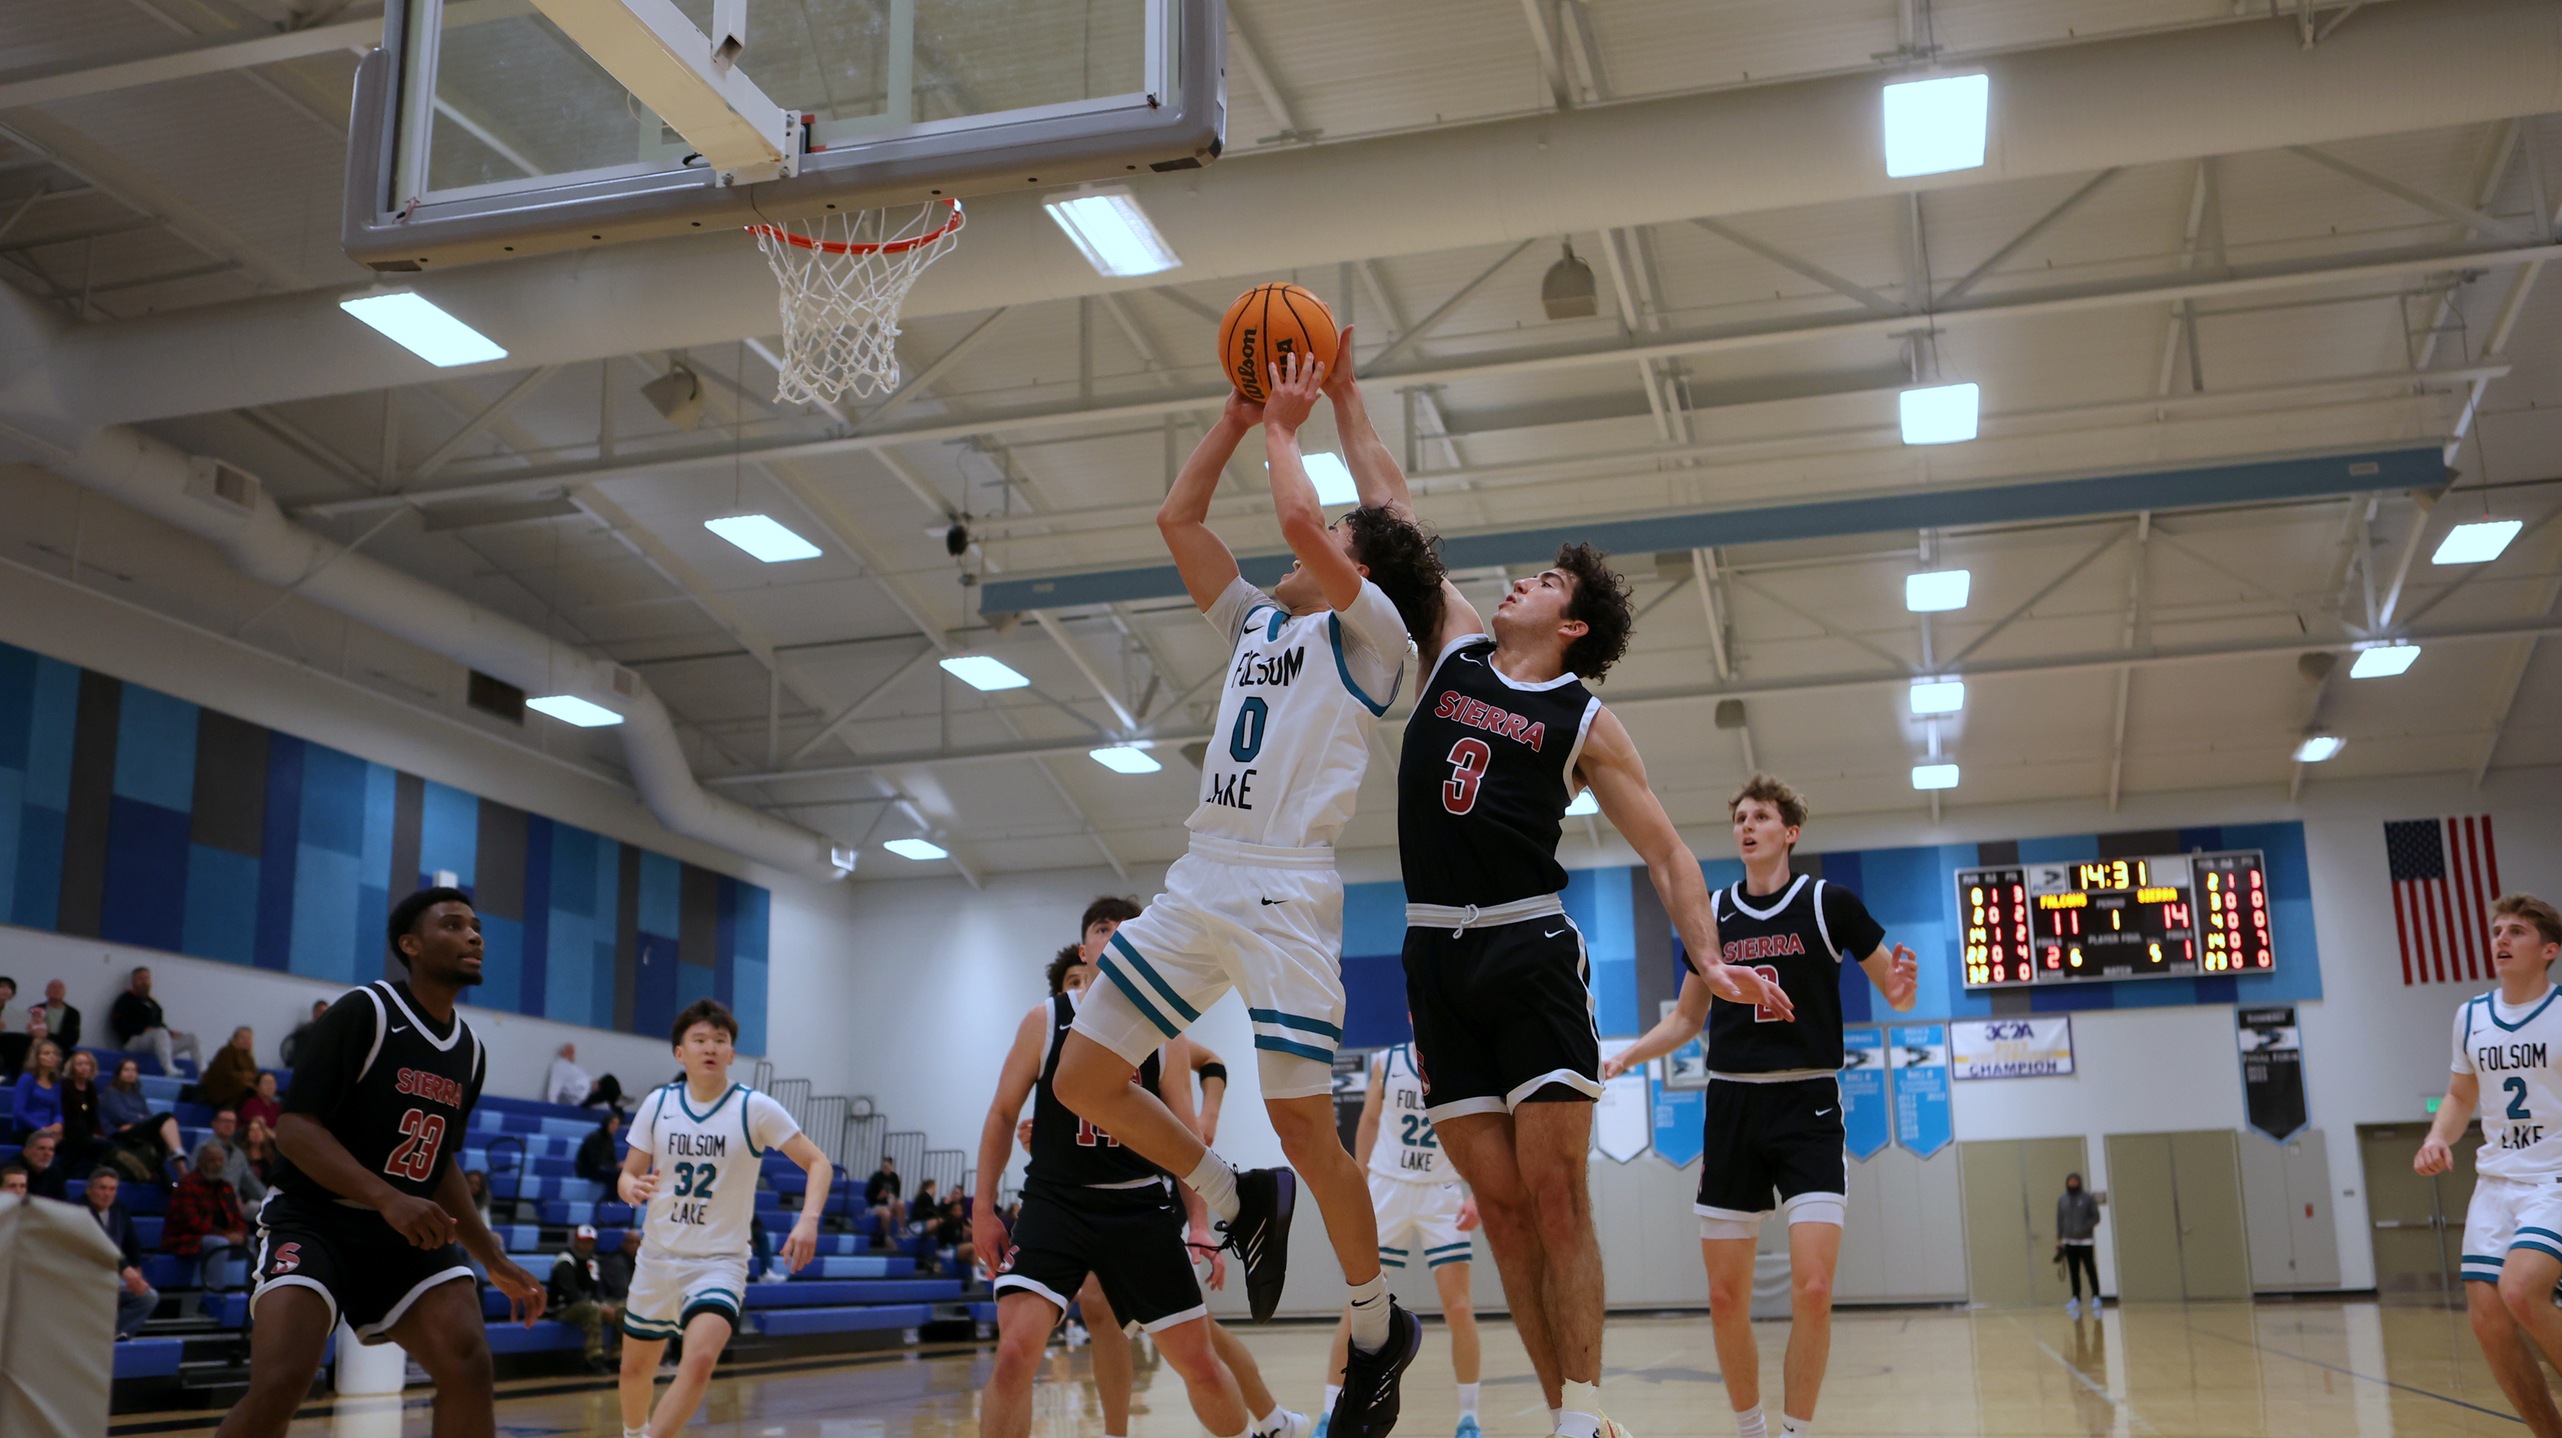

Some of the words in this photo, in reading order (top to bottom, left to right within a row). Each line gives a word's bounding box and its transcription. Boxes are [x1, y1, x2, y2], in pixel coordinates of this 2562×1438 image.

[1237, 328, 1265, 399] Wilson
[1229, 696, 1268, 762] 0
[1434, 690, 1545, 752] SIERRA
[1442, 737, 1491, 816] 3
[1205, 769, 1257, 810] AKE
[2080, 860, 2147, 890] 14:31
[2228, 872, 2235, 889] 1
[1991, 887, 1998, 903] 1
[2013, 884, 2024, 903] 3
[2040, 892, 2088, 910] FALCONS
[2137, 886, 2178, 904] SIERRA
[2224, 891, 2237, 910] 0
[2251, 889, 2263, 909] 0
[1988, 906, 2000, 924] 0
[2014, 904, 2025, 923] 2
[2053, 909, 2079, 936] 11
[2112, 908, 2121, 931] 1
[2163, 902, 2189, 930] 14
[2210, 912, 2224, 929] 4
[2226, 910, 2240, 930] 0
[2253, 909, 2266, 928] 0
[1969, 926, 1987, 944] 14
[1994, 926, 2002, 942] 1
[2015, 924, 2026, 942] 2
[2207, 932, 2226, 950] 14
[2229, 930, 2241, 950] 0
[2256, 929, 2268, 947] 7
[1724, 933, 1805, 964] SIERRA
[1991, 944, 2003, 963] 0
[2016, 944, 2029, 960] 4
[2046, 945, 2061, 969] 2
[2069, 947, 2083, 968] 6
[2184, 939, 2193, 960] 1
[2231, 950, 2244, 970] 0
[2257, 948, 2270, 968] 0
[1993, 964, 2005, 982] 0
[2018, 962, 2031, 981] 0
[1969, 1060, 2057, 1077] CHAMPION
[2479, 1043, 2547, 1072] FOLSOM
[395, 1067, 463, 1110] SIERRA
[2503, 1076, 2531, 1120] 2
[1401, 1114, 1437, 1148] 22
[384, 1108, 445, 1182] 23
[668, 1133, 726, 1157] FOLSOM
[1401, 1150, 1434, 1172] LAKE
[674, 1162, 716, 1199] 32
[671, 1202, 707, 1225] LAKE
